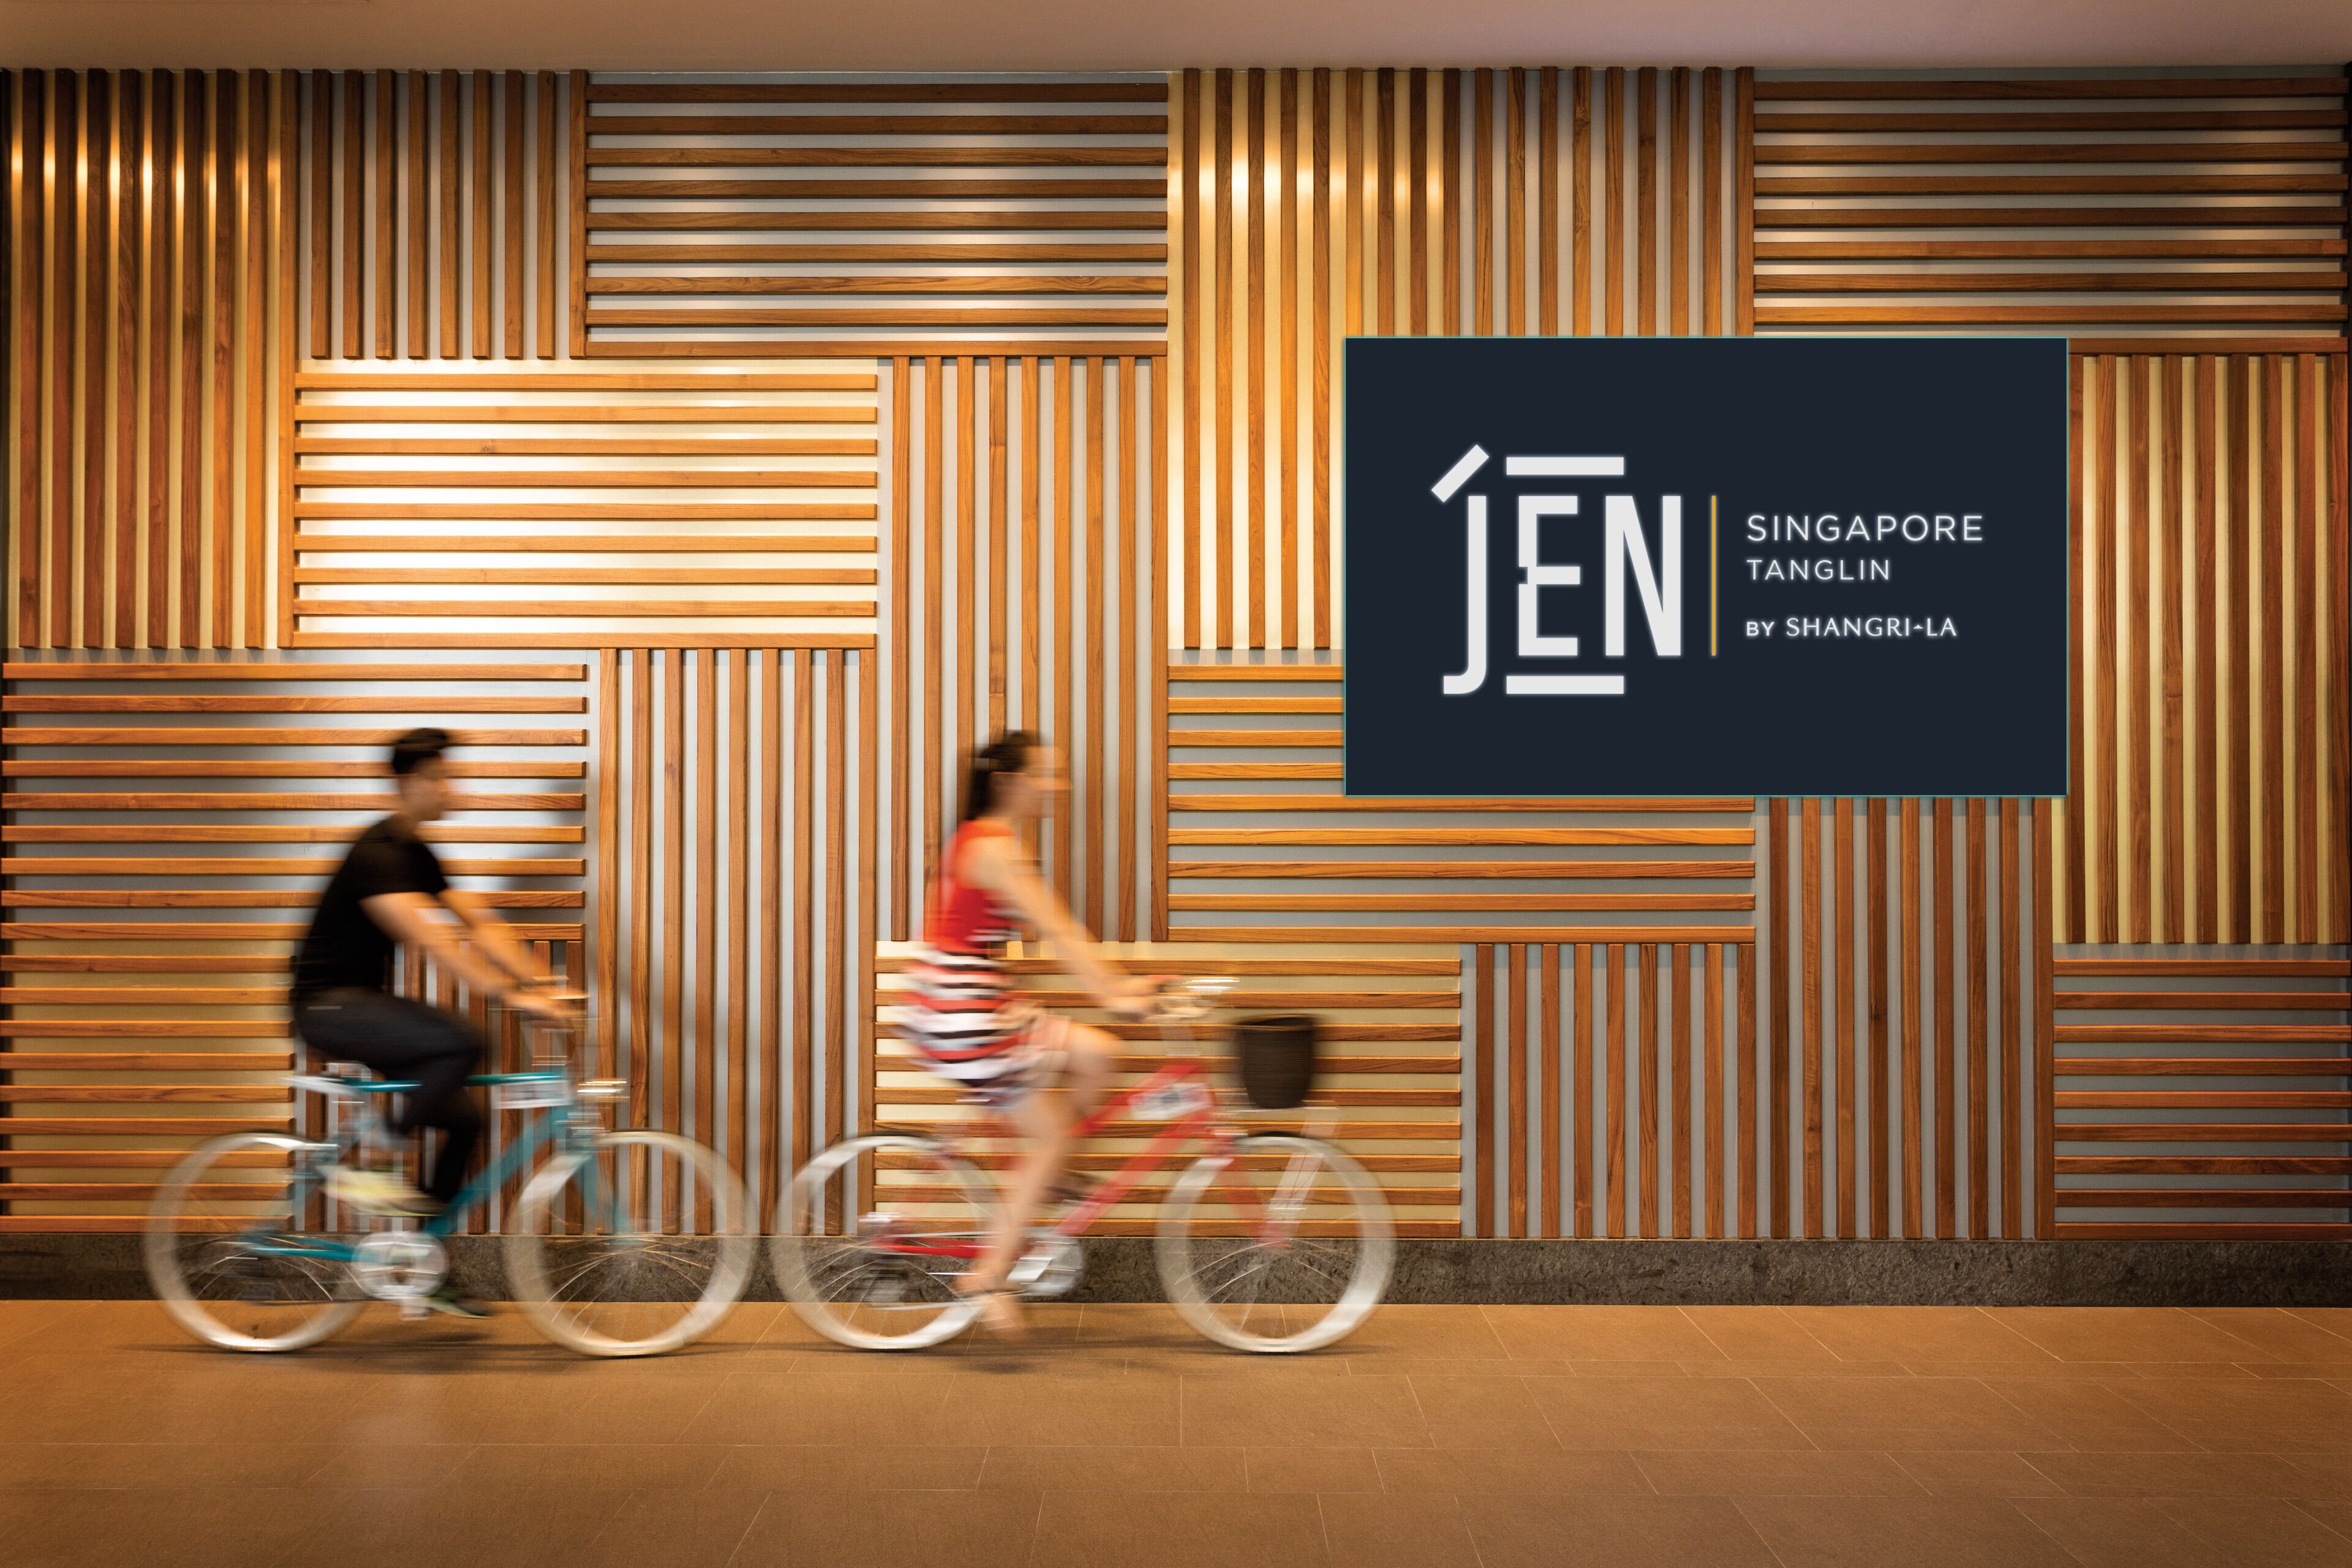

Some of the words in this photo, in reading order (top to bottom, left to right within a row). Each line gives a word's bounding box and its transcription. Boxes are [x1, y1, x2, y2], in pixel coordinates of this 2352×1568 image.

[1746, 514, 1983, 541] SINGAPORE
[1431, 445, 1682, 695] JEN
[1746, 559, 1890, 580] TANGLIN
[1746, 620, 1775, 636] BY
[1785, 617, 1958, 636] SHANGRI-LA
